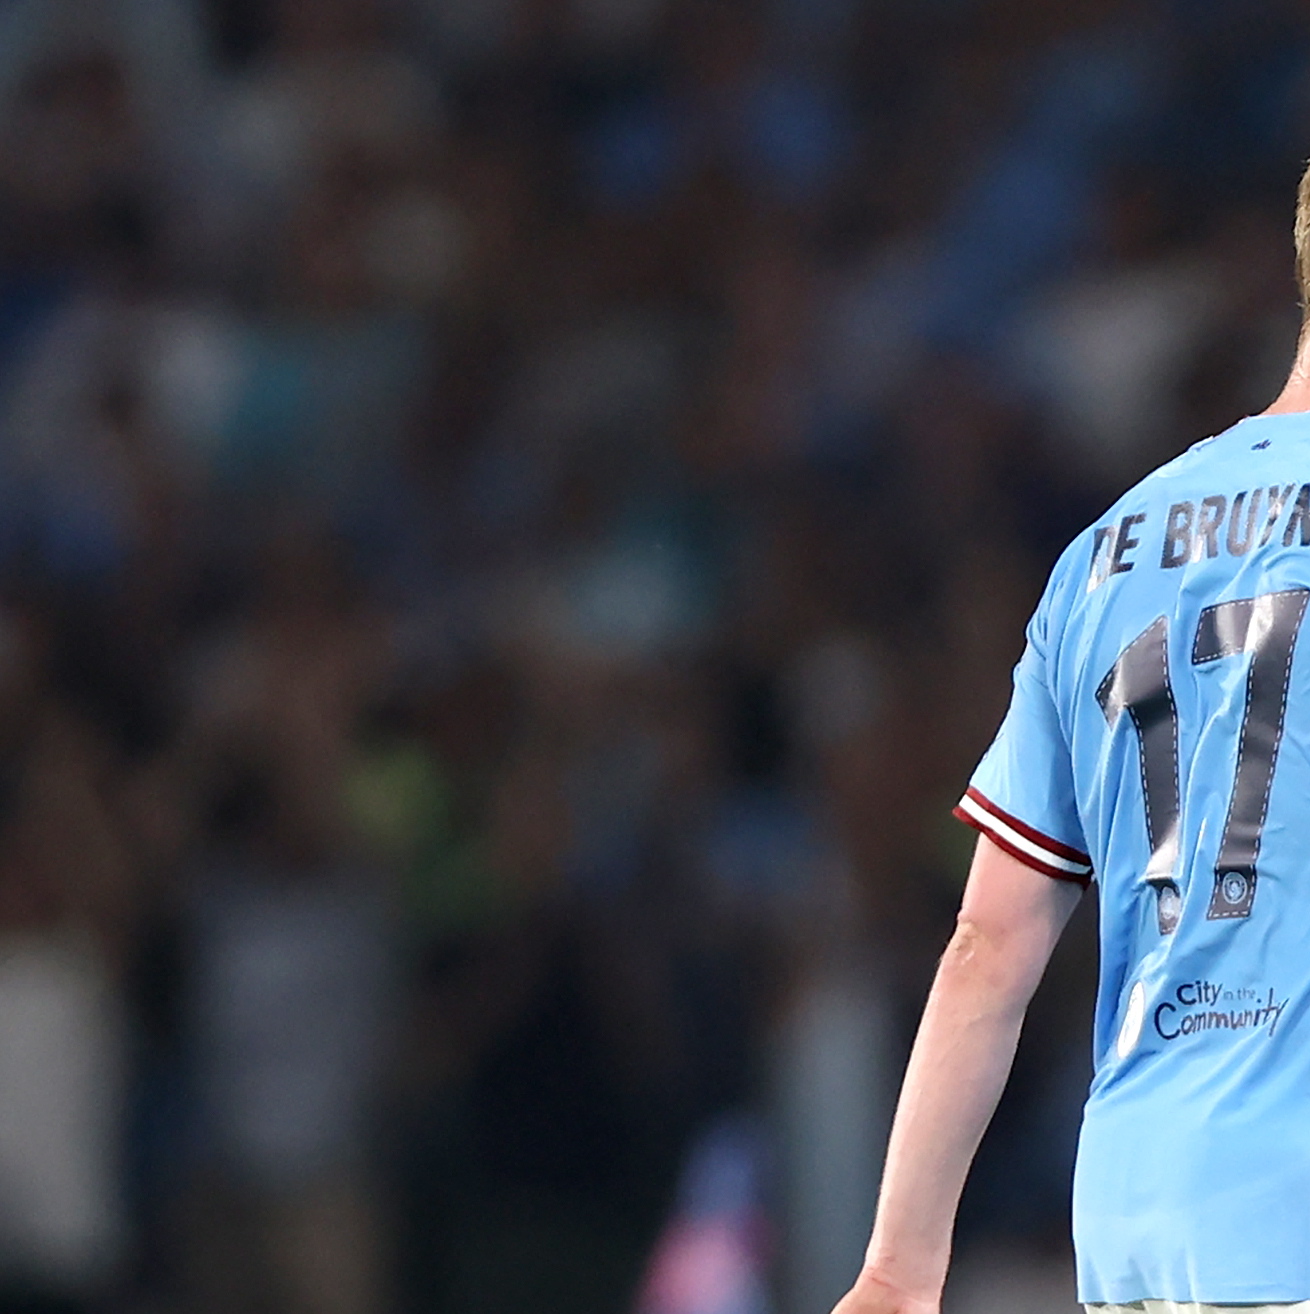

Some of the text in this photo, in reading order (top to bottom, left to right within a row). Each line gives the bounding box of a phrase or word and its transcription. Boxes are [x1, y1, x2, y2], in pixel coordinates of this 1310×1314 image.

[1086, 512, 1147, 595] DE
[1154, 986, 1290, 1040] Community
[1176, 980, 1224, 1007] City
